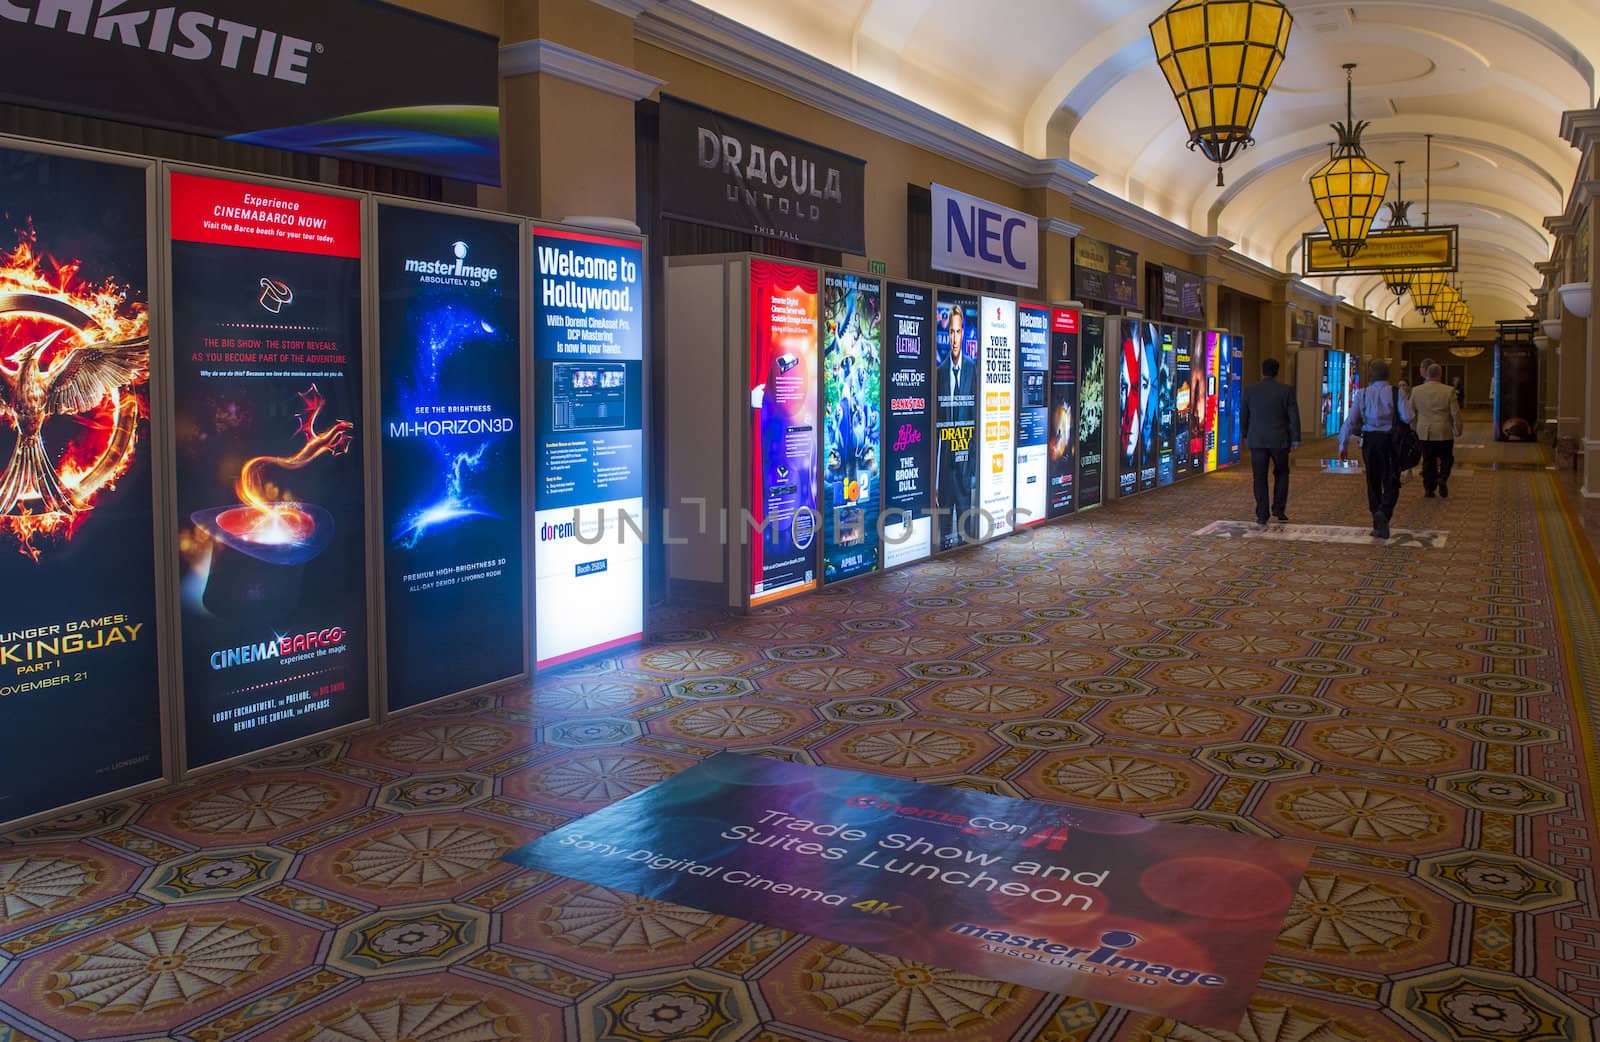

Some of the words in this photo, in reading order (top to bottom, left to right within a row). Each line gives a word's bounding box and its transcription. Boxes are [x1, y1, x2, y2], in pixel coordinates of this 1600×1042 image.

[698, 127, 842, 203] DRACULA
[244, 193, 300, 211] Experience
[727, 184, 820, 220] UNTOLD
[214, 205, 295, 225] CINEMABARCO
[298, 217, 327, 230] NOW!
[203, 221, 219, 231] Visit
[221, 222, 232, 231] the
[234, 223, 254, 234] Barco
[256, 226, 274, 236] booth
[276, 228, 286, 238] for
[287, 230, 301, 240] your
[302, 232, 315, 241] tour
[316, 233, 335, 244] today.
[754, 225, 775, 235] THIS
[779, 230, 799, 241] FALL
[947, 197, 1027, 270] NEC
[538, 246, 617, 282] Welcome
[621, 256, 636, 283] to
[420, 276, 467, 286] ABSOLUTELY
[858, 281, 879, 293] AMAZON
[543, 279, 633, 314] Hollywood.
[547, 314, 564, 327] With
[565, 315, 588, 329] Doremi
[898, 319, 920, 336] BARELY
[1020, 312, 1043, 330] Welcome
[204, 338, 219, 347] THE
[221, 338, 235, 348] BIG
[266, 340, 279, 348] THE
[281, 340, 304, 349] STORY
[567, 329, 580, 340] DCP
[581, 330, 613, 344] Mastering
[990, 336, 1008, 347] YOUR
[564, 343, 579, 354] now
[580, 342, 586, 354] in
[987, 347, 1011, 359] TICKET
[192, 352, 202, 361] AS
[205, 352, 222, 361] YOU
[224, 353, 256, 362] BECOME
[258, 354, 277, 362] PART
[279, 354, 289, 362] OF
[291, 354, 304, 363] THE
[986, 360, 996, 372] TO
[998, 360, 1011, 372] THE
[200, 371, 211, 379] Why
[891, 373, 910, 382] JOHN
[910, 373, 925, 382] DOE
[986, 373, 1011, 384] MOVIES
[415, 406, 430, 414] SEE
[432, 405, 446, 414] THE
[447, 404, 491, 413] BRIGHTNESS
[390, 417, 514, 438] MI-HORIZON3D
[941, 426, 975, 440] DRAFT
[951, 438, 970, 452] DAY
[900, 457, 914, 468] THE
[895, 467, 919, 481] BRONX
[898, 480, 916, 492] BULL
[541, 517, 576, 542] doremi
[841, 556, 857, 569] APRIL
[857, 554, 863, 566] 11
[403, 571, 434, 582] PREMIUM
[436, 560, 496, 576] HIGH-BRIGHTNESS
[409, 582, 434, 592] ALL-DAY
[435, 578, 455, 588] DEMOS
[66, 615, 128, 632] GAMES:
[280, 651, 315, 665] experience
[316, 648, 327, 657] the
[328, 644, 347, 656] magic
[16, 661, 52, 675] PART
[74, 671, 88, 682] 21
[212, 709, 233, 723] LOBBY
[286, 690, 311, 705] PRELUDE,
[234, 718, 256, 732] BEHIND
[257, 716, 268, 726] THE
[269, 708, 295, 723] CURTAIN,
[304, 699, 330, 714] APPLAUSE
[758, 808, 868, 841] Trade
[878, 833, 1002, 867] Show
[1011, 858, 1110, 888] and
[559, 833, 627, 857] Sony
[625, 848, 723, 879] Digital
[722, 870, 848, 907] Cinema
[850, 898, 905, 918] 4K
[720, 825, 849, 861] Suites
[857, 849, 1094, 911] Luncheon
[978, 941, 1117, 978] ABSOLUTELY
[1126, 973, 1160, 988] 3D
